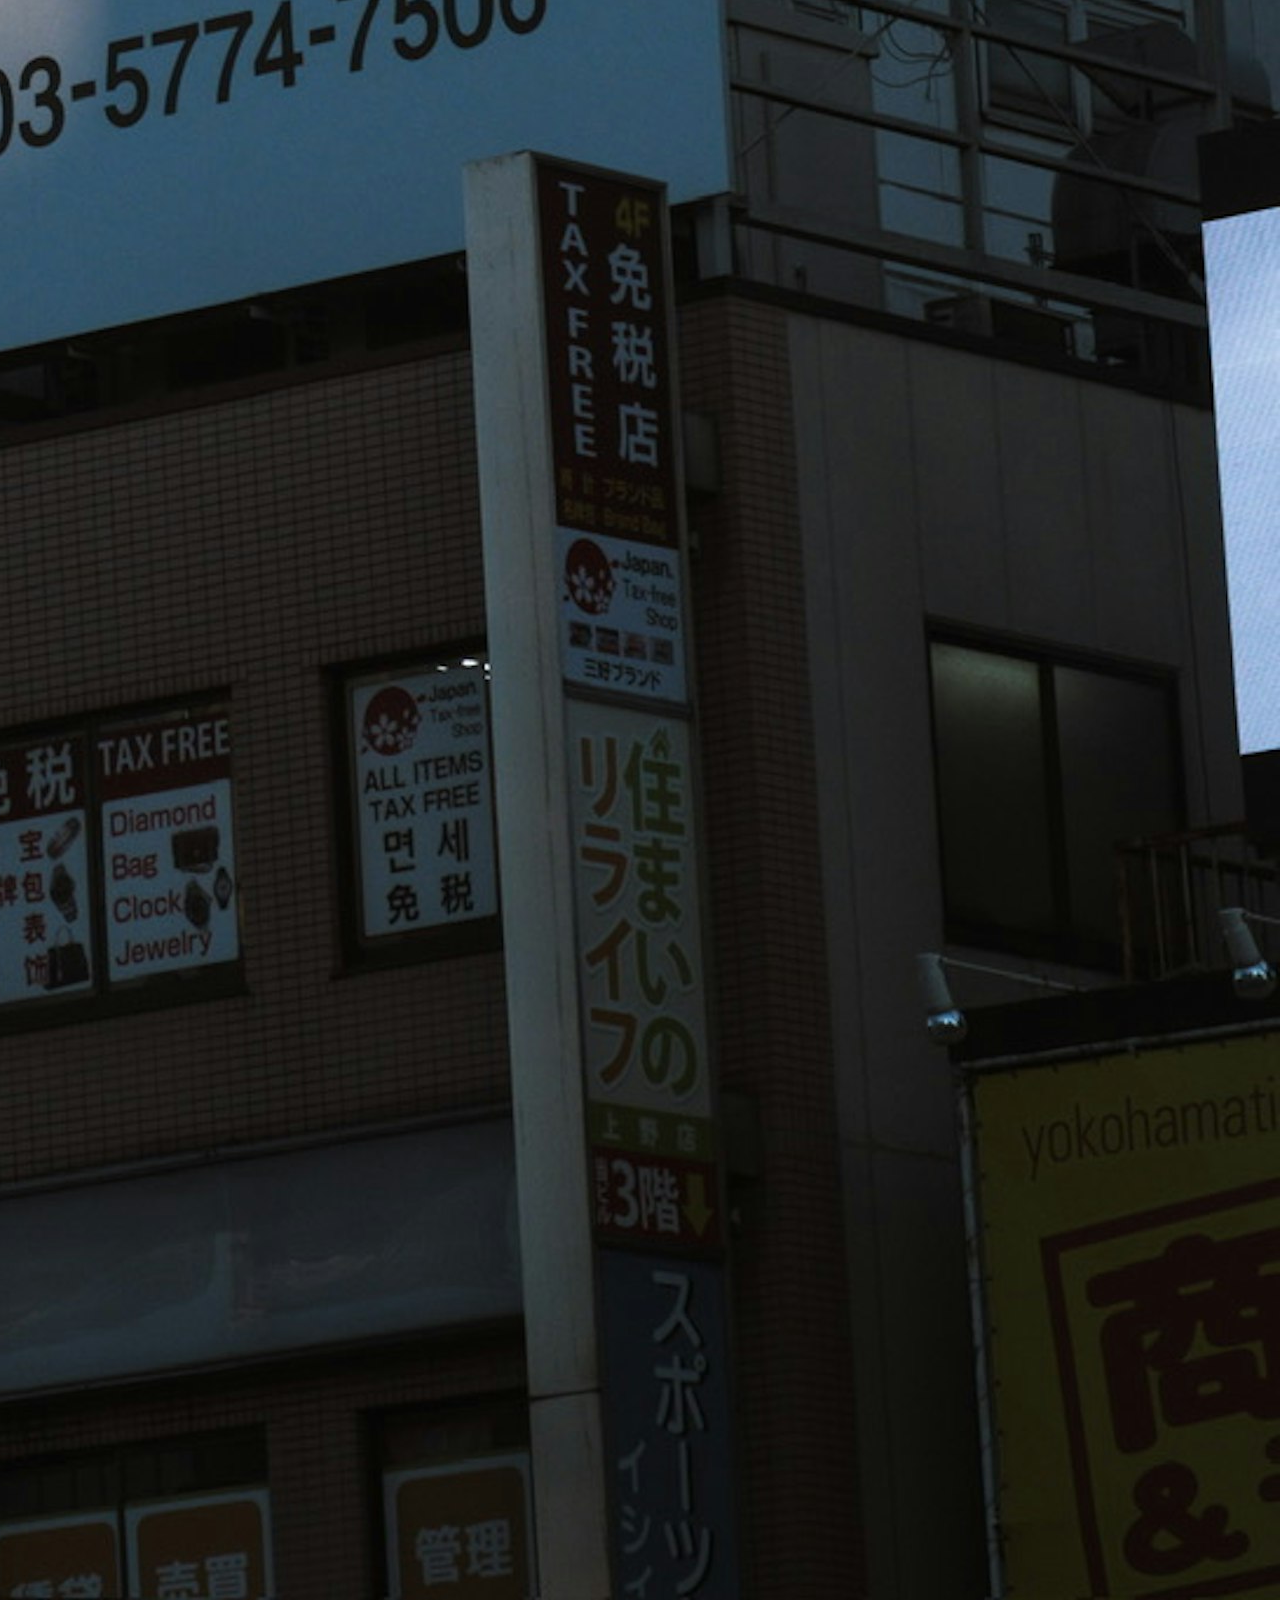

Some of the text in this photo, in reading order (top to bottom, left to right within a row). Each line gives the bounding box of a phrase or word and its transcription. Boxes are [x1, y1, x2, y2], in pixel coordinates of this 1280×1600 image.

[557, 180, 590, 297] TAX
[566, 305, 599, 460] FREE
[607, 241, 660, 470] 免税店
[97, 717, 231, 777] TAX FREE
[364, 749, 484, 794] ALL ITEMS
[109, 794, 217, 838] Diamond
[369, 781, 481, 823] TAX FREE
[111, 852, 158, 881] Bag
[387, 870, 475, 925] 免税
[112, 888, 185, 924] Clock
[580, 735, 637, 1086] リライフ
[623, 726, 701, 1096] 住まいの
[115, 929, 213, 967] Jewelry
[610, 1158, 681, 1235] 3階
[651, 1269, 713, 1596] スポーツ
[414, 1516, 515, 1587] 管理
